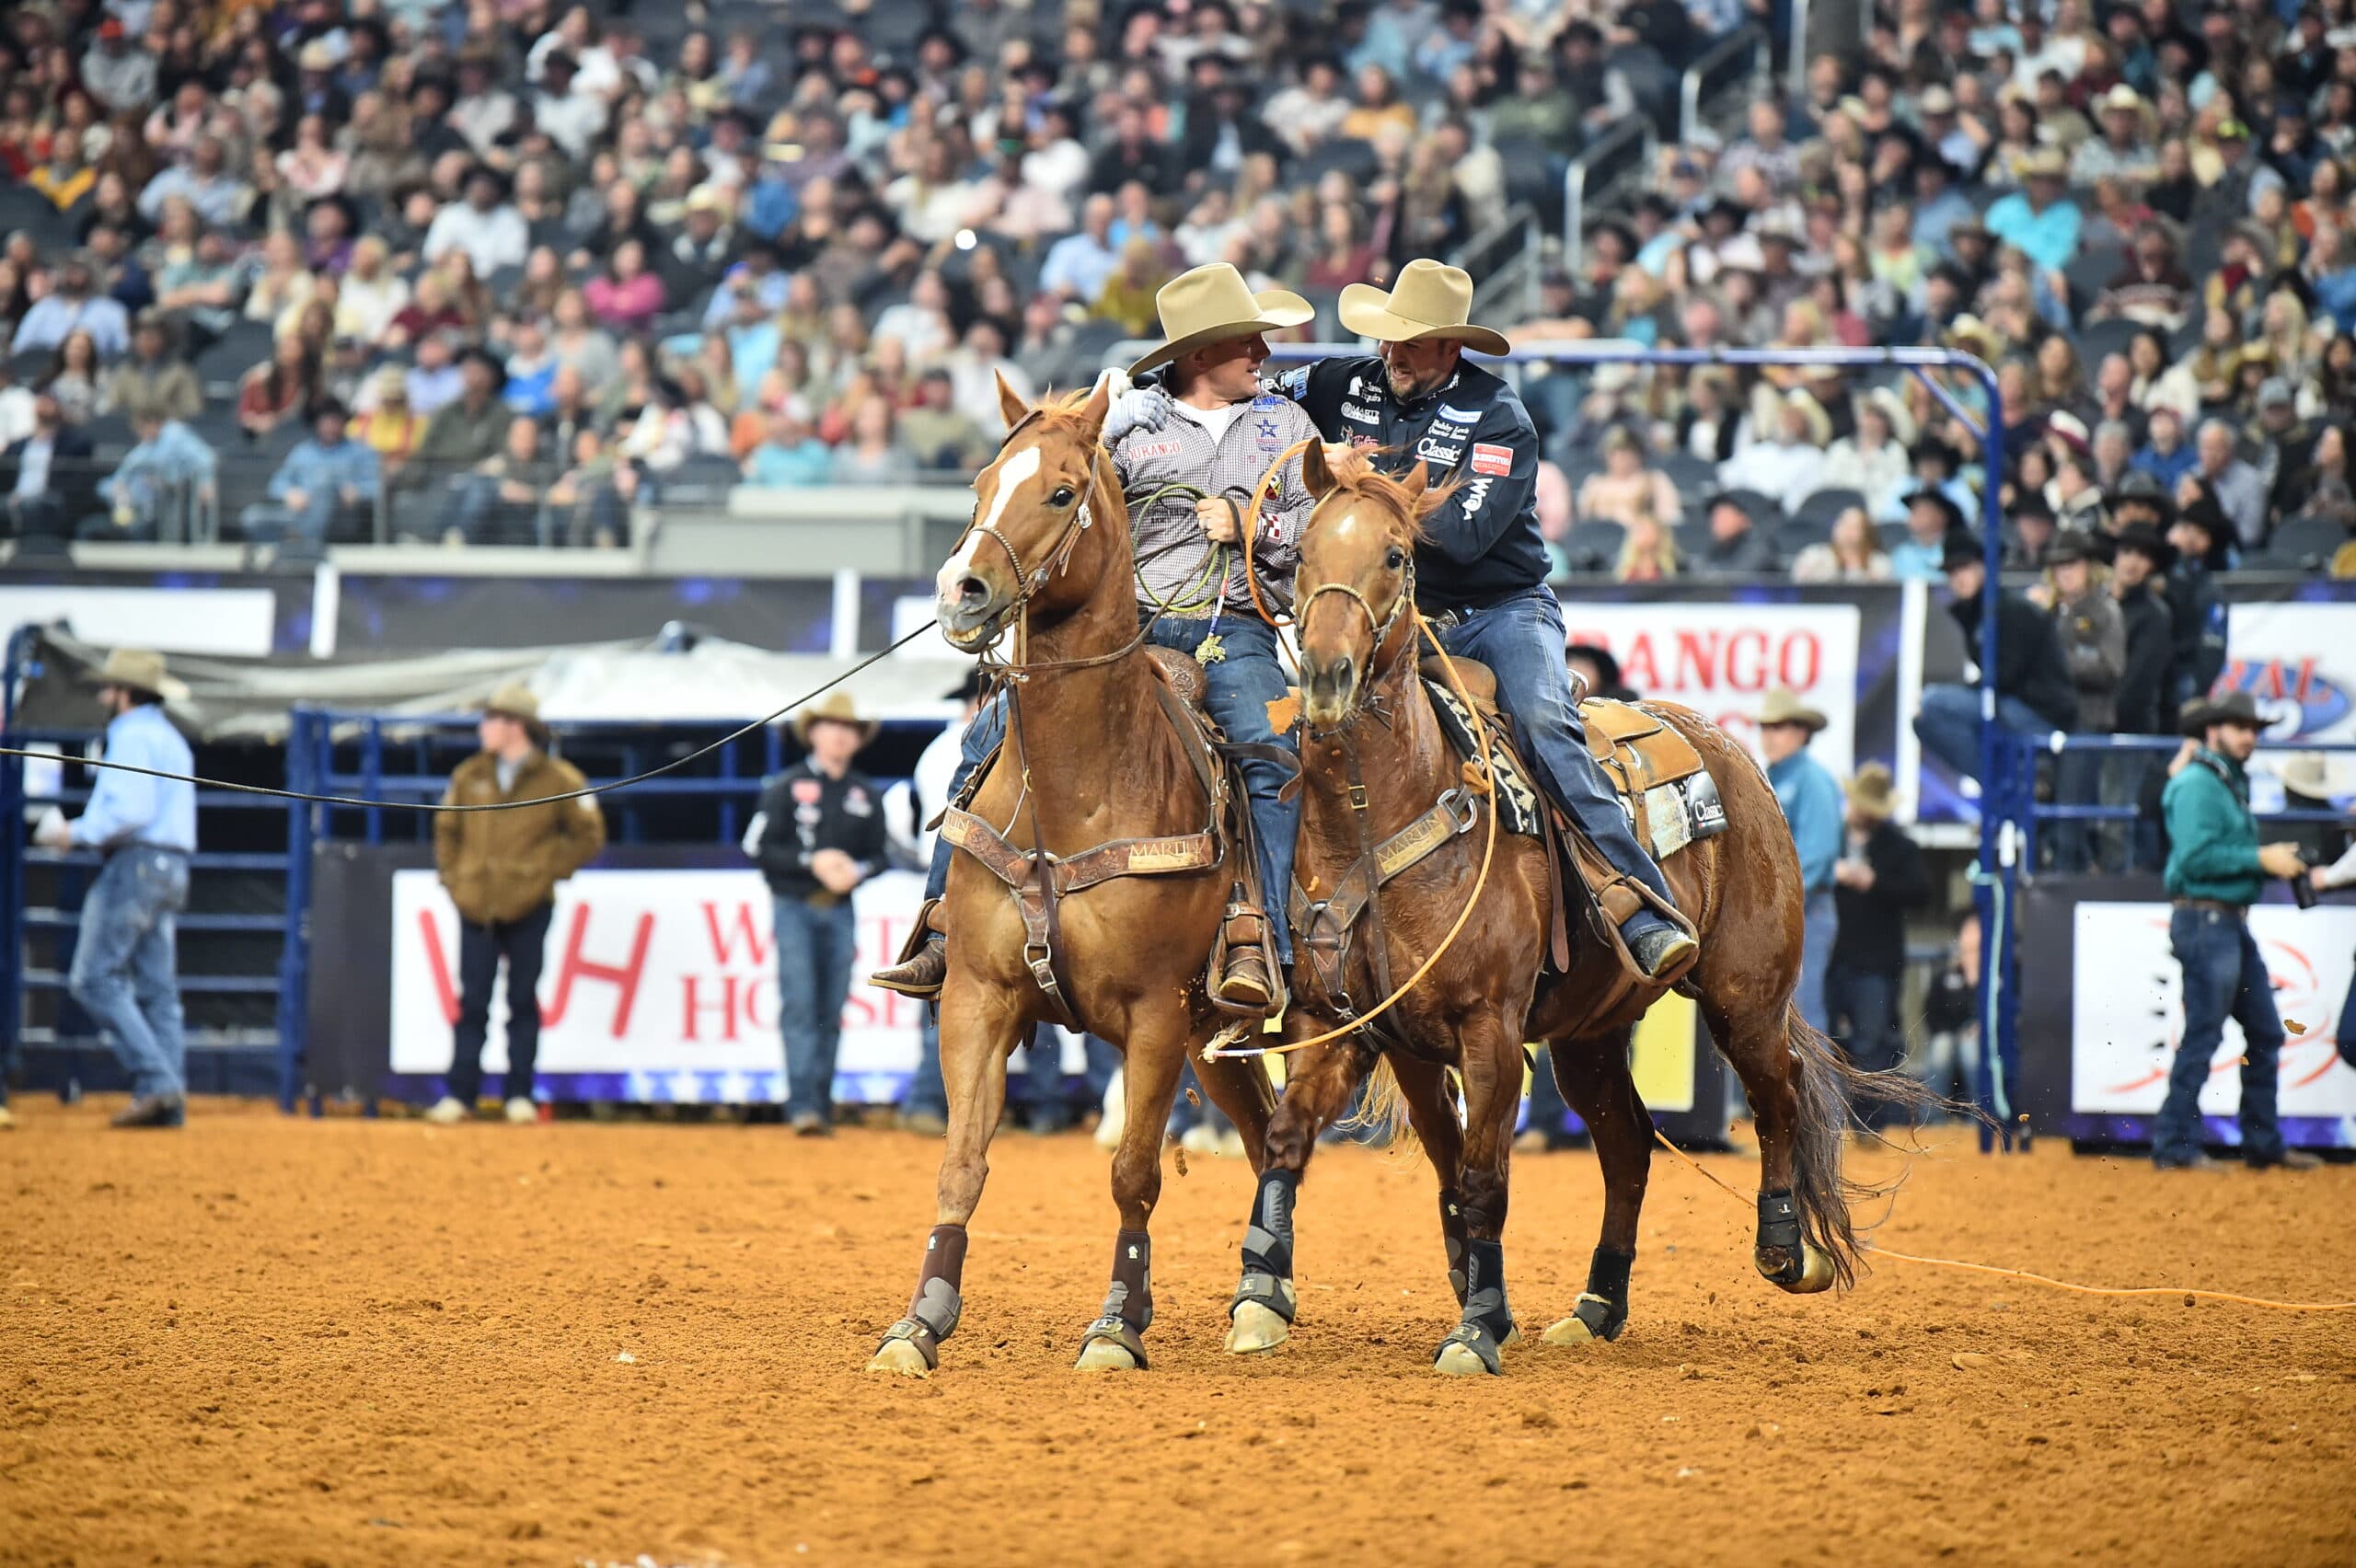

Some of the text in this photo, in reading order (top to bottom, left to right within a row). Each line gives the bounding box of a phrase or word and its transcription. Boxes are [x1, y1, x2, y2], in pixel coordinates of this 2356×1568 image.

[1127, 442, 1182, 461] DURANGO
[1417, 437, 1462, 462] Classic
[1694, 799, 1724, 822] Classic
[1377, 811, 1443, 864] MARTIN
[699, 899, 920, 966] WT
[677, 974, 921, 1043] HOSE
